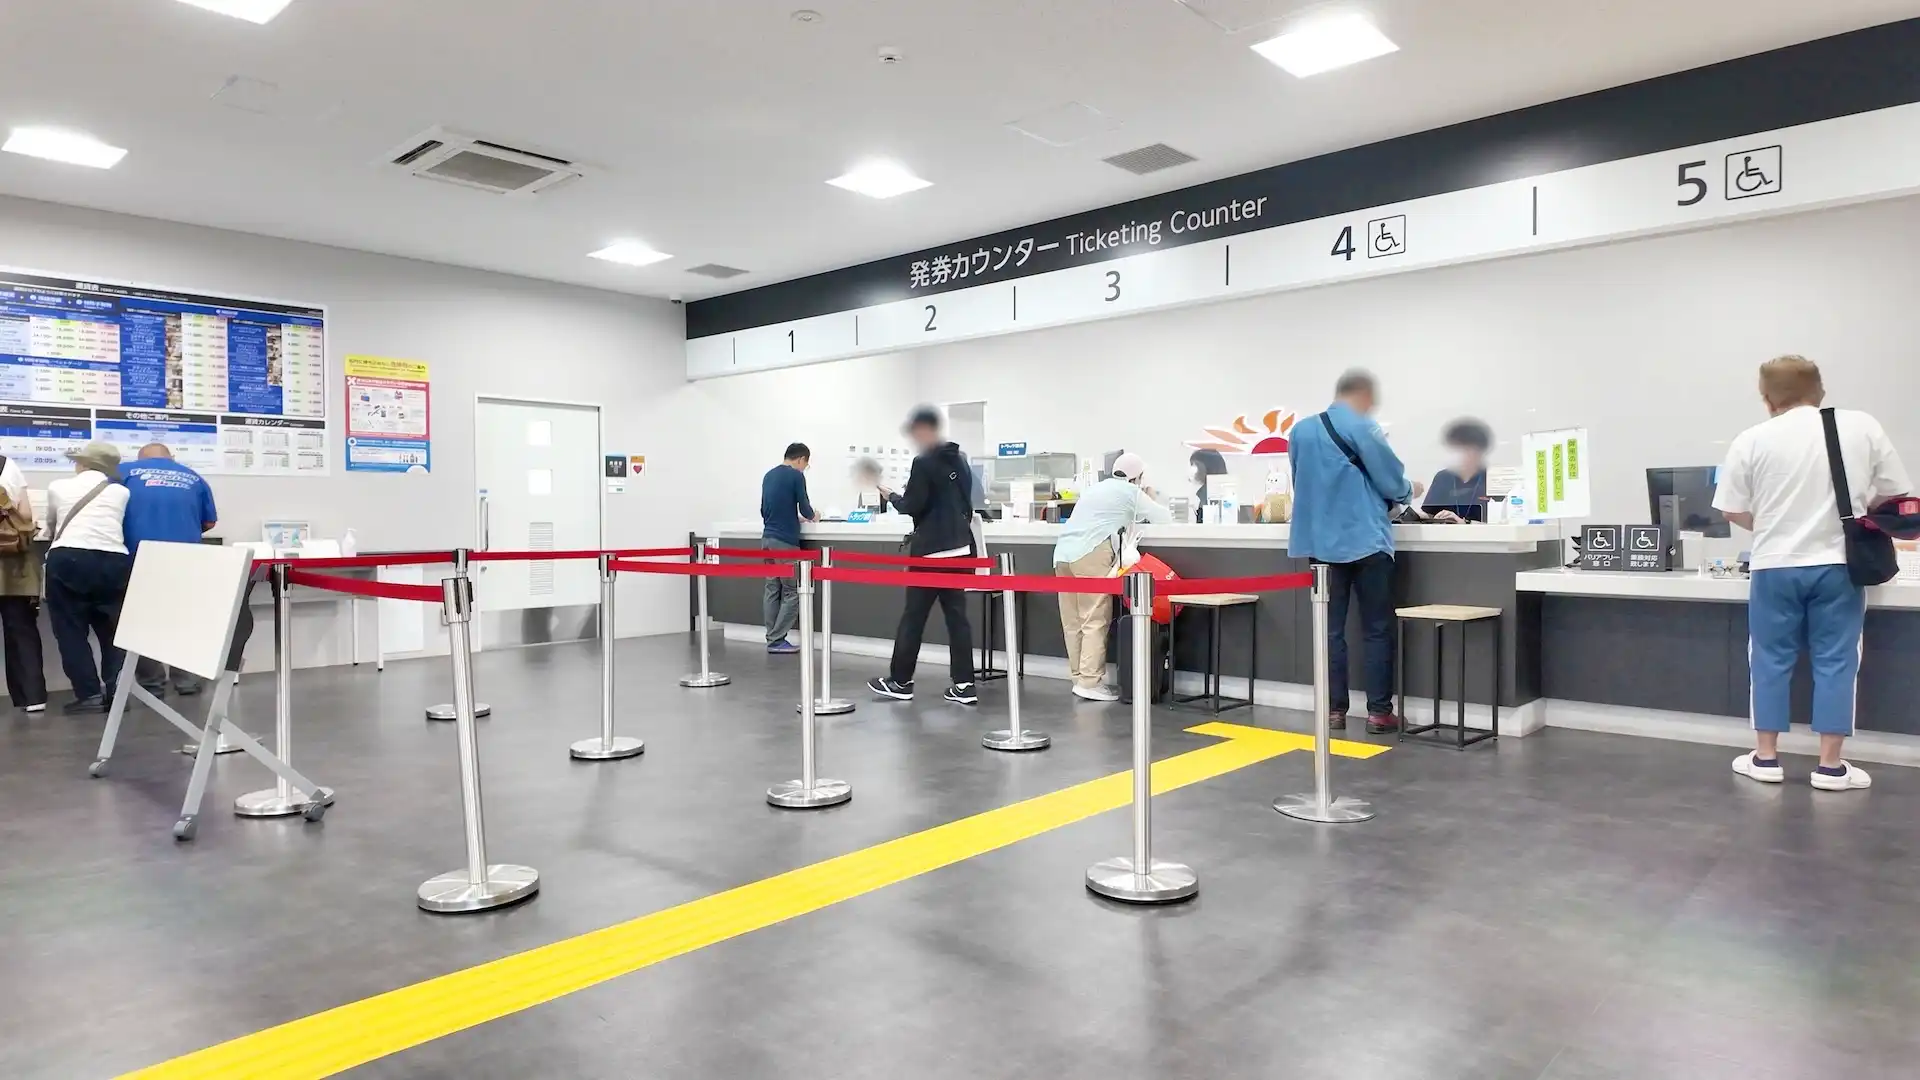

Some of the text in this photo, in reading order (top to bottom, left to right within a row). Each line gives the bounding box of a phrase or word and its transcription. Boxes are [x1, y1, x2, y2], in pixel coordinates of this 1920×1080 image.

[1677, 160, 1708, 207] 5
[909, 196, 1268, 290] 発券カウンター Ticketing Counter
[1330, 225, 1356, 261] 4
[1104, 271, 1121, 302] 3
[924, 305, 937, 332] 2
[788, 330, 794, 353] 1
